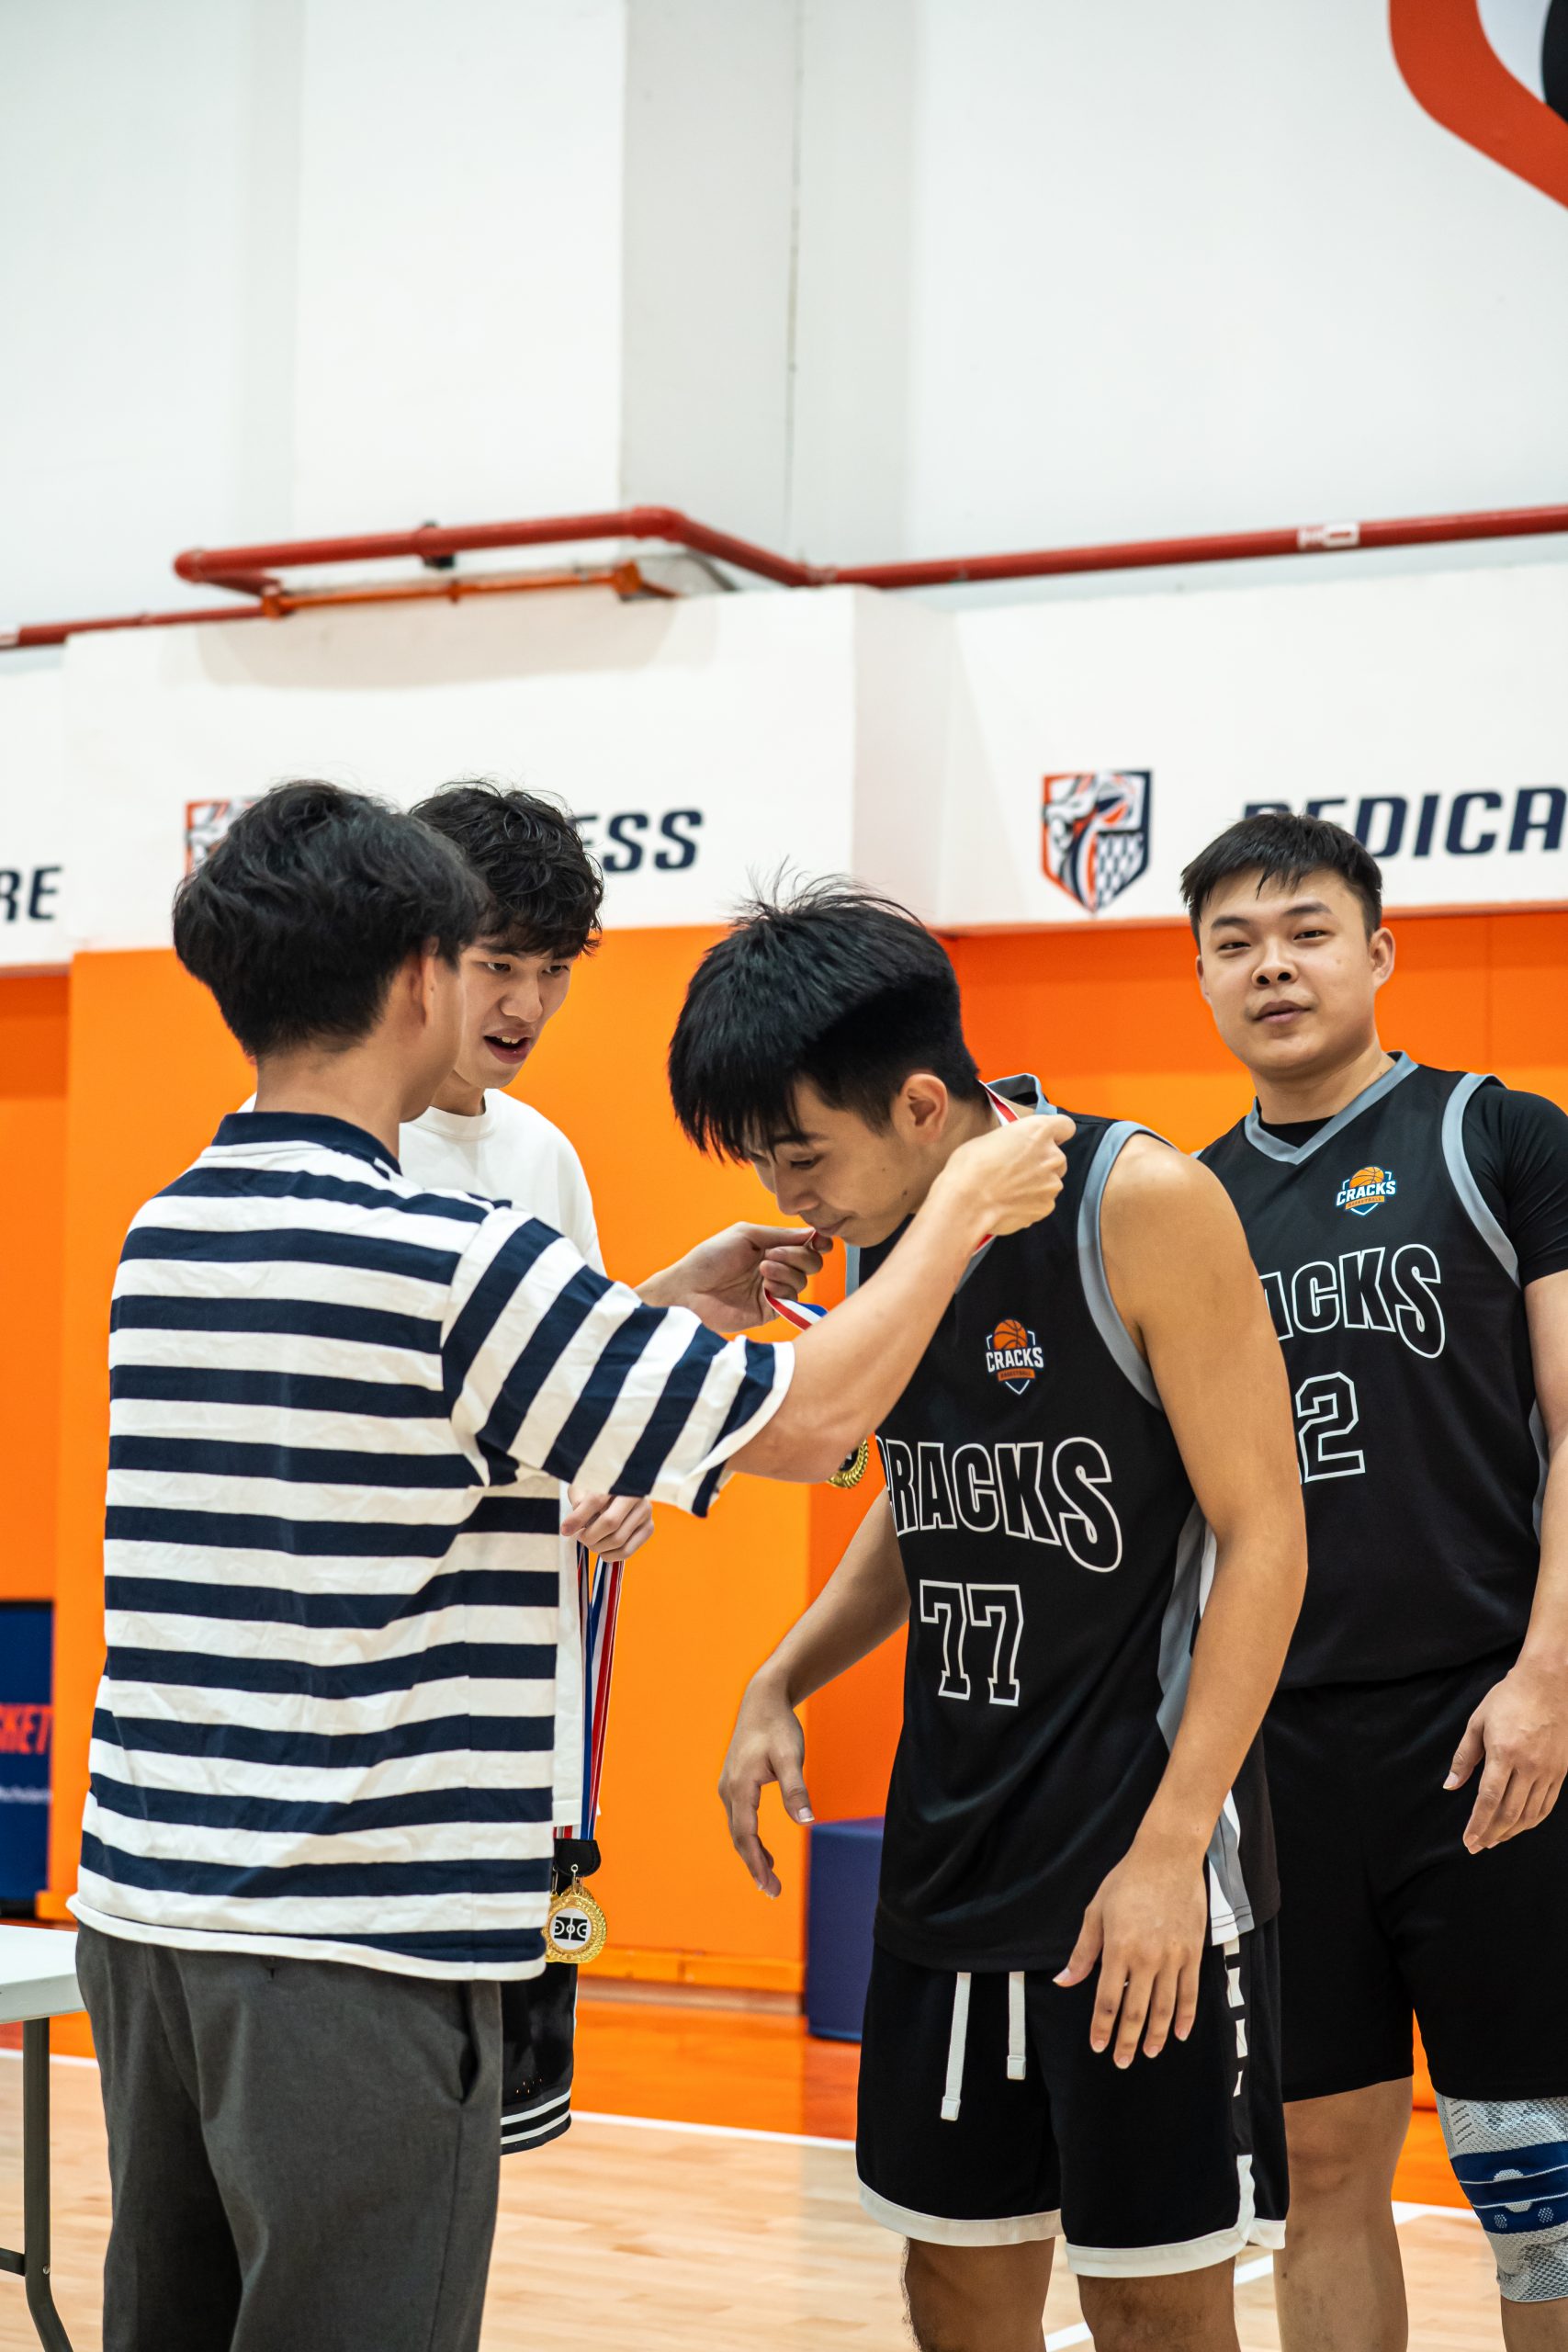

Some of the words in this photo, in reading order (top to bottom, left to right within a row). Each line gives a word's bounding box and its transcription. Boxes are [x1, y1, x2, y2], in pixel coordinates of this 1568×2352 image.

[1243, 786, 1567, 858] DICA
[1336, 1180, 1396, 1206] CRACKS
[986, 1346, 1044, 1373] CRACKS
[919, 1579, 1024, 1707] 77
